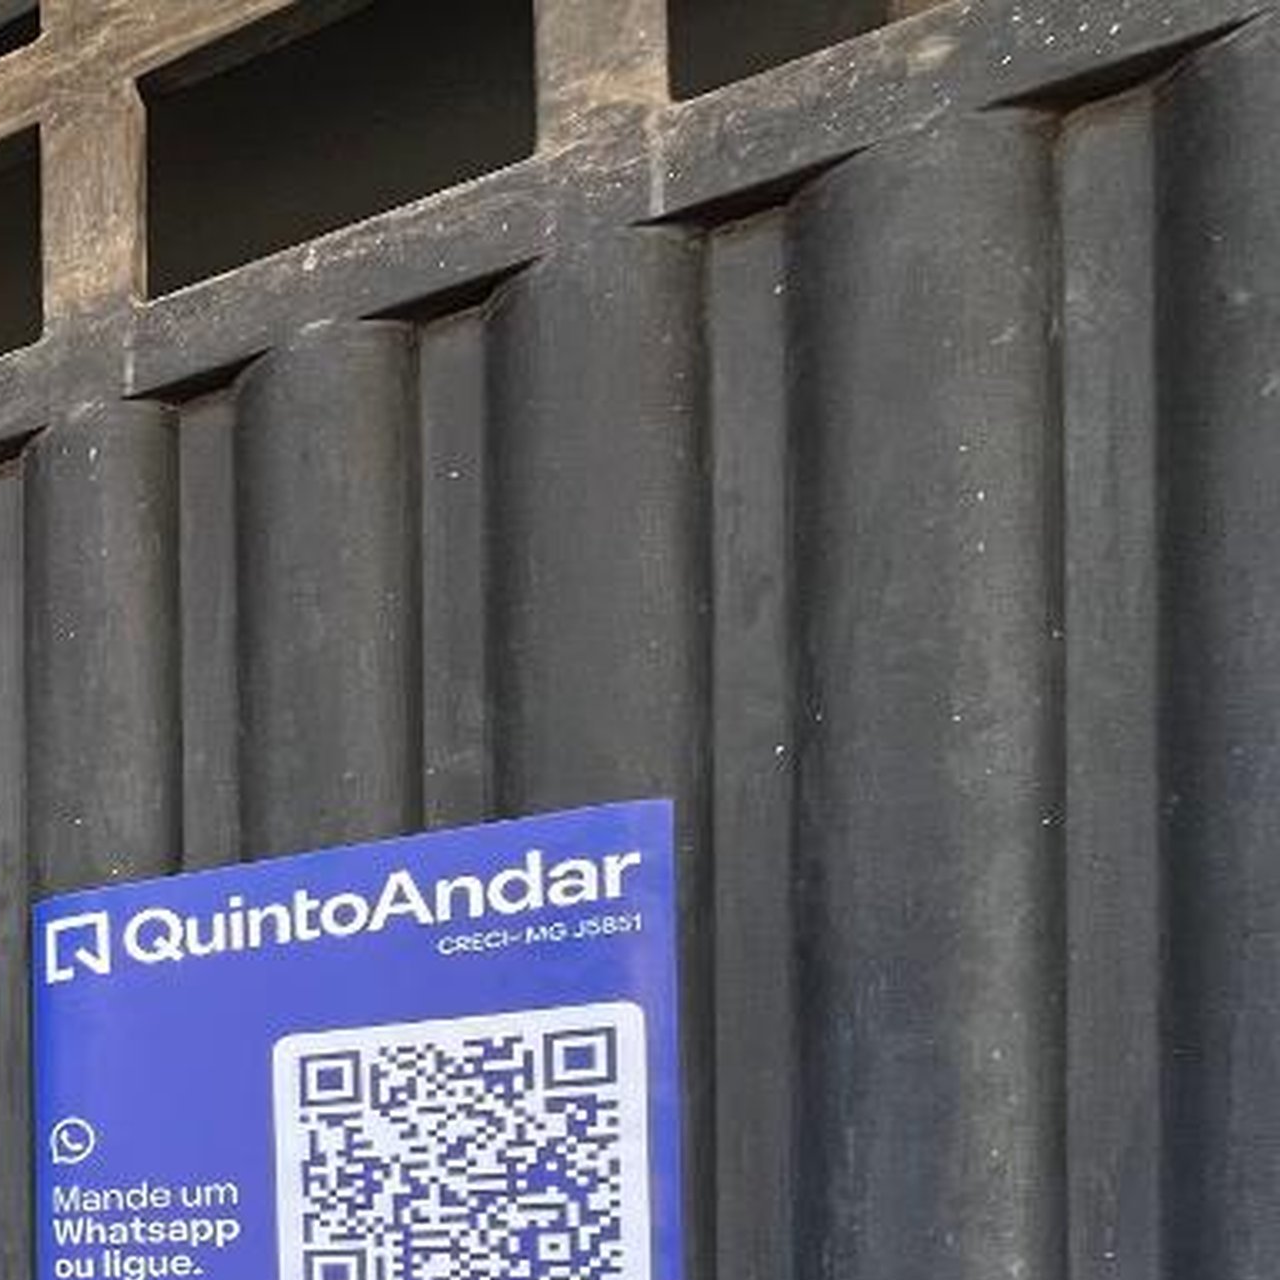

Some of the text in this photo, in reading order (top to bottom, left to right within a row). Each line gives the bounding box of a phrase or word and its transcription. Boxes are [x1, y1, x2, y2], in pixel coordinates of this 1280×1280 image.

[123, 848, 642, 964] QuintoAndar
[52, 1180, 239, 1213] Mande um
[52, 1216, 241, 1248] Whatsapp
[54, 1257, 95, 1279] ou
